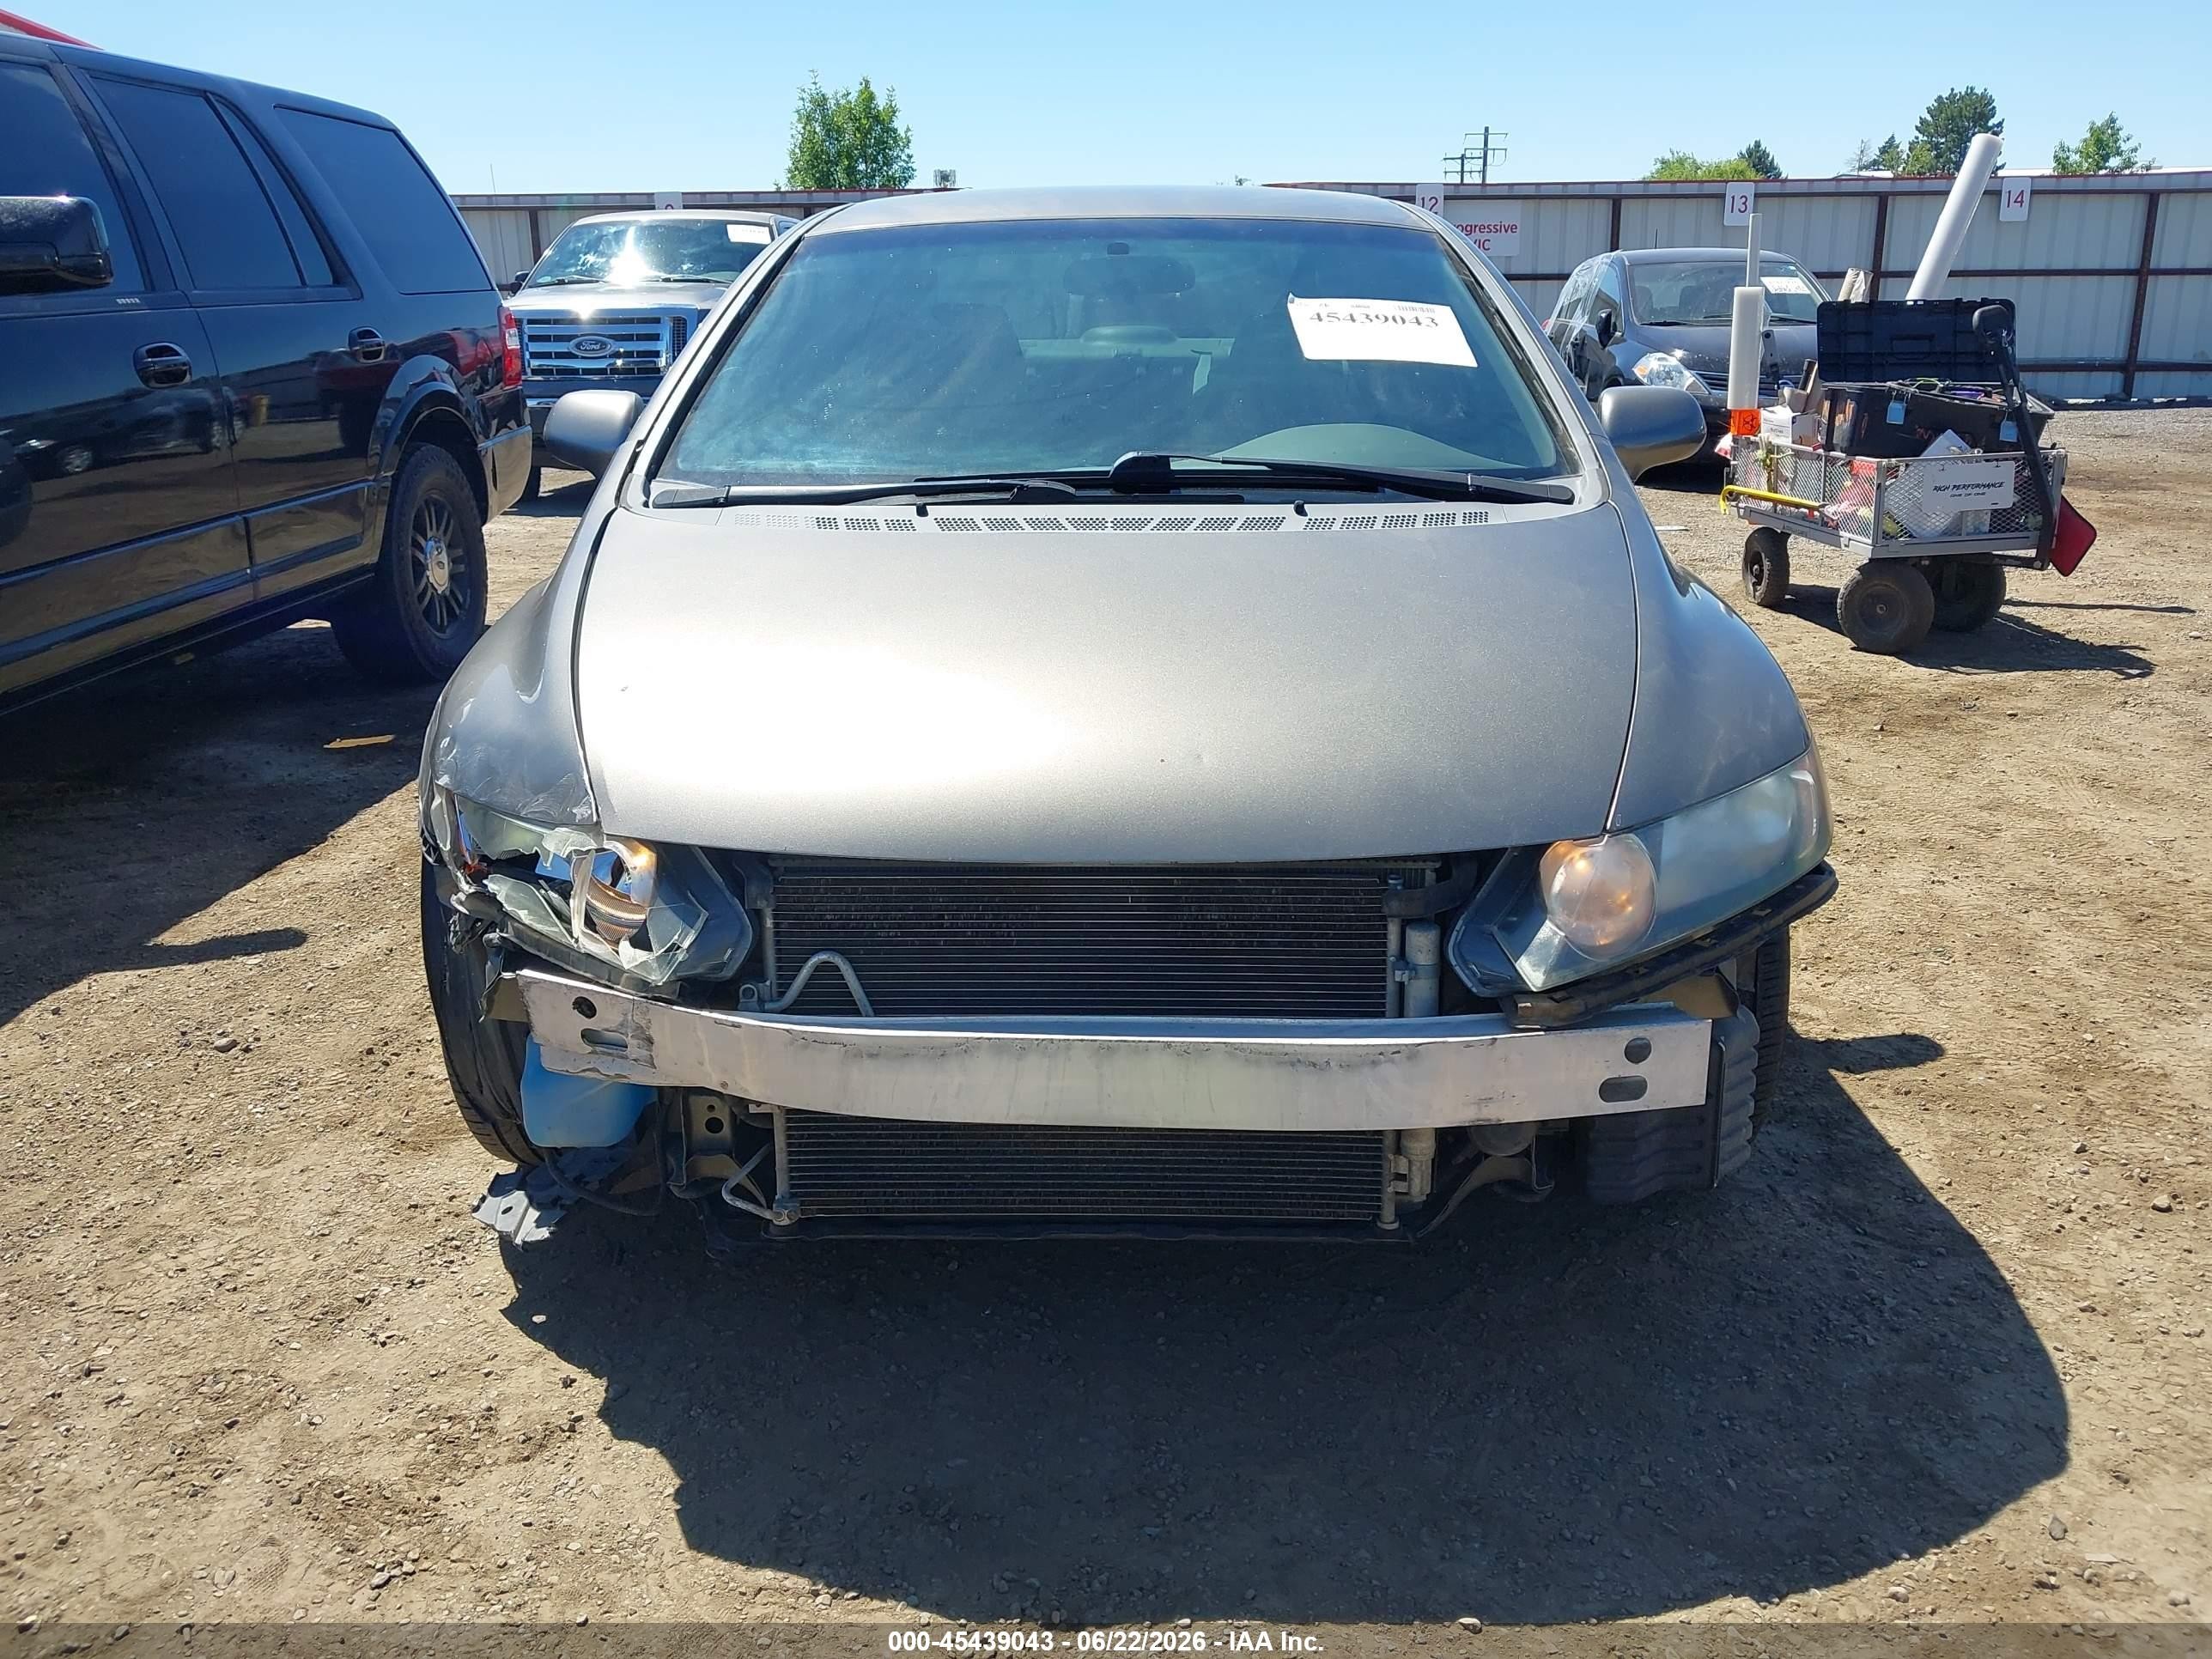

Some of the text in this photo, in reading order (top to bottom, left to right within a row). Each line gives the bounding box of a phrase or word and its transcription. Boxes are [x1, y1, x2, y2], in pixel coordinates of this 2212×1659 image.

[1420, 196, 1438, 214] 12
[1730, 194, 1748, 214] 13
[2006, 189, 2025, 208] 14
[1453, 221, 1518, 236] ogressive
[1308, 311, 1439, 328] 45439043
[1951, 481, 2006, 490] PERFORMANCE
